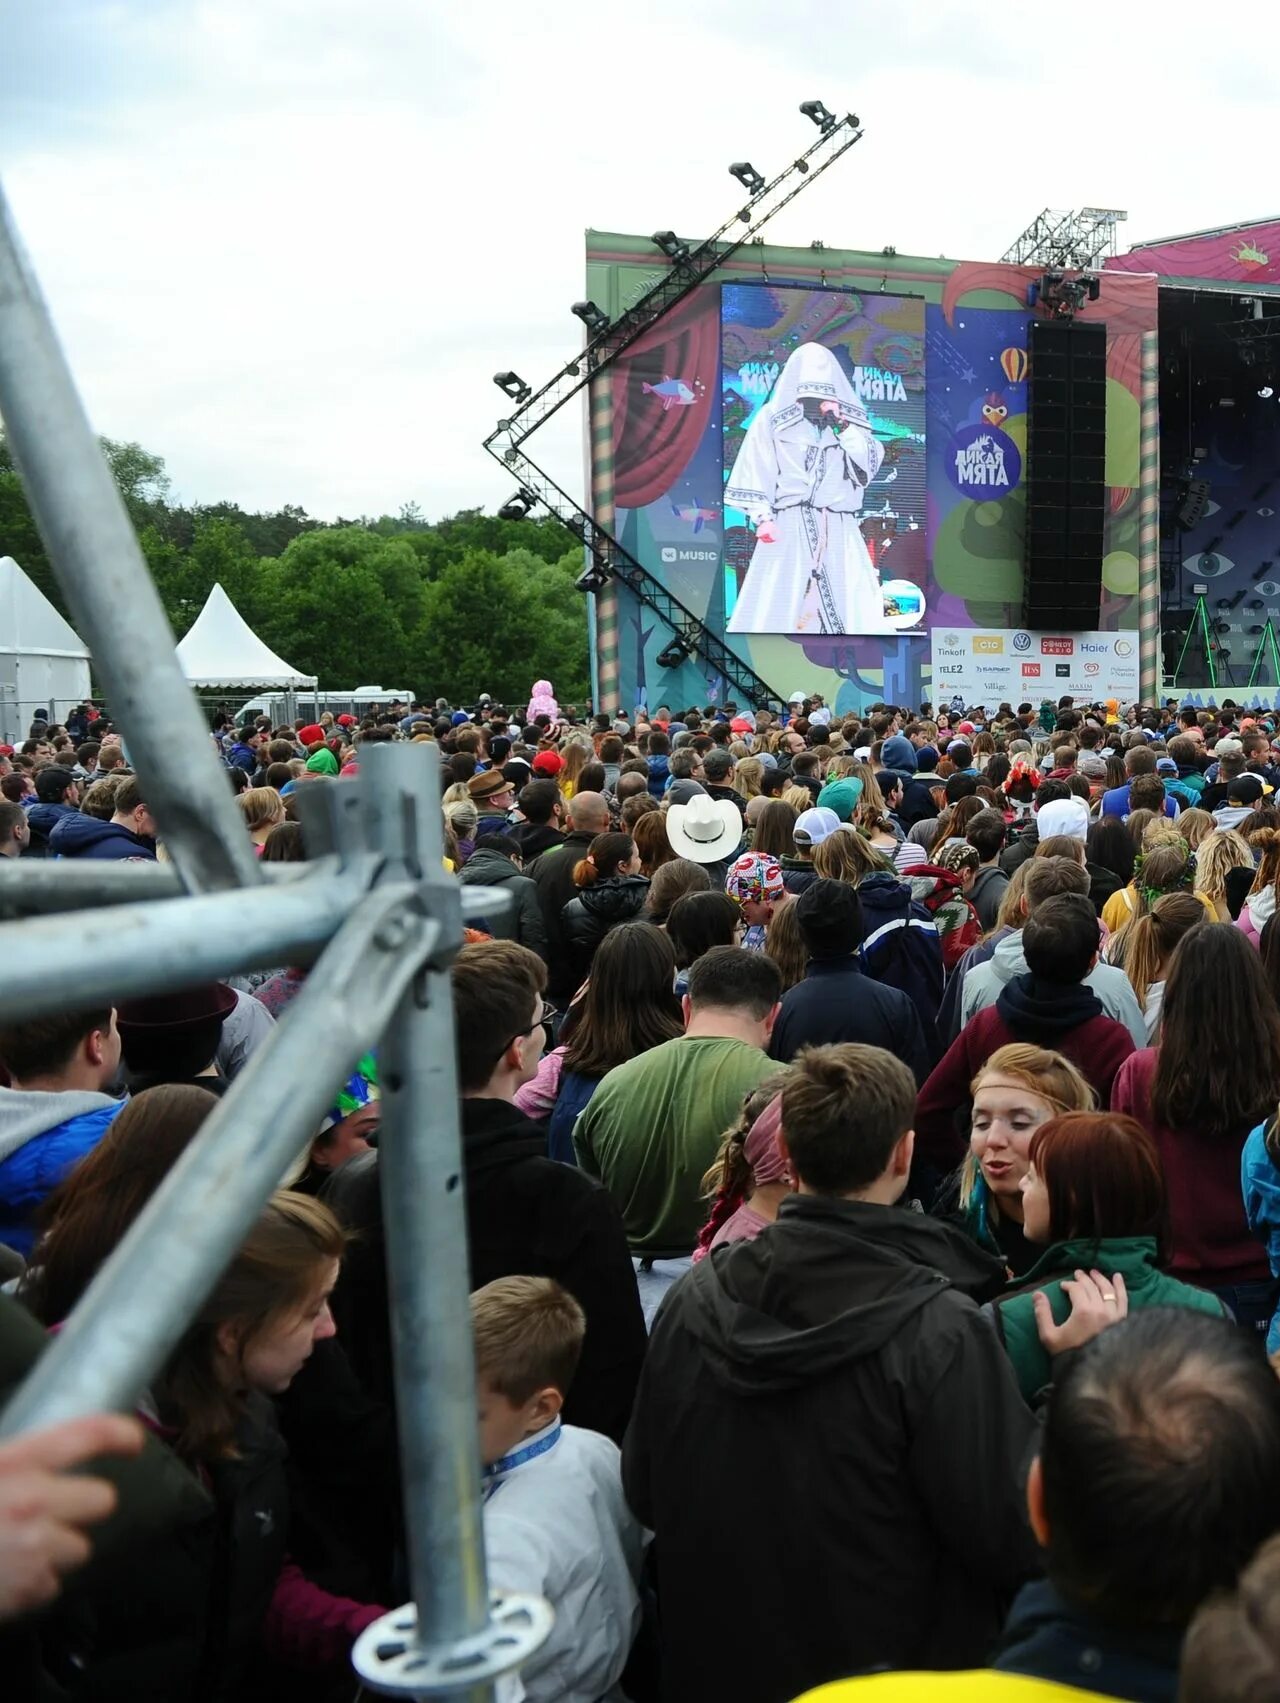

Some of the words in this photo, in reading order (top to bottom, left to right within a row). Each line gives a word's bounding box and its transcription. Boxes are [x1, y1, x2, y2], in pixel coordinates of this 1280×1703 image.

[738, 362, 780, 376] ДИКА
[855, 379, 907, 401] МЯТА
[955, 450, 1004, 466] ДИКАЯ
[958, 464, 1009, 486] МЯТА
[679, 550, 718, 561] MUSIC
[938, 648, 966, 656] Tinkoff
[1081, 643, 1109, 652] Haier
[939, 664, 963, 674] TELE2
